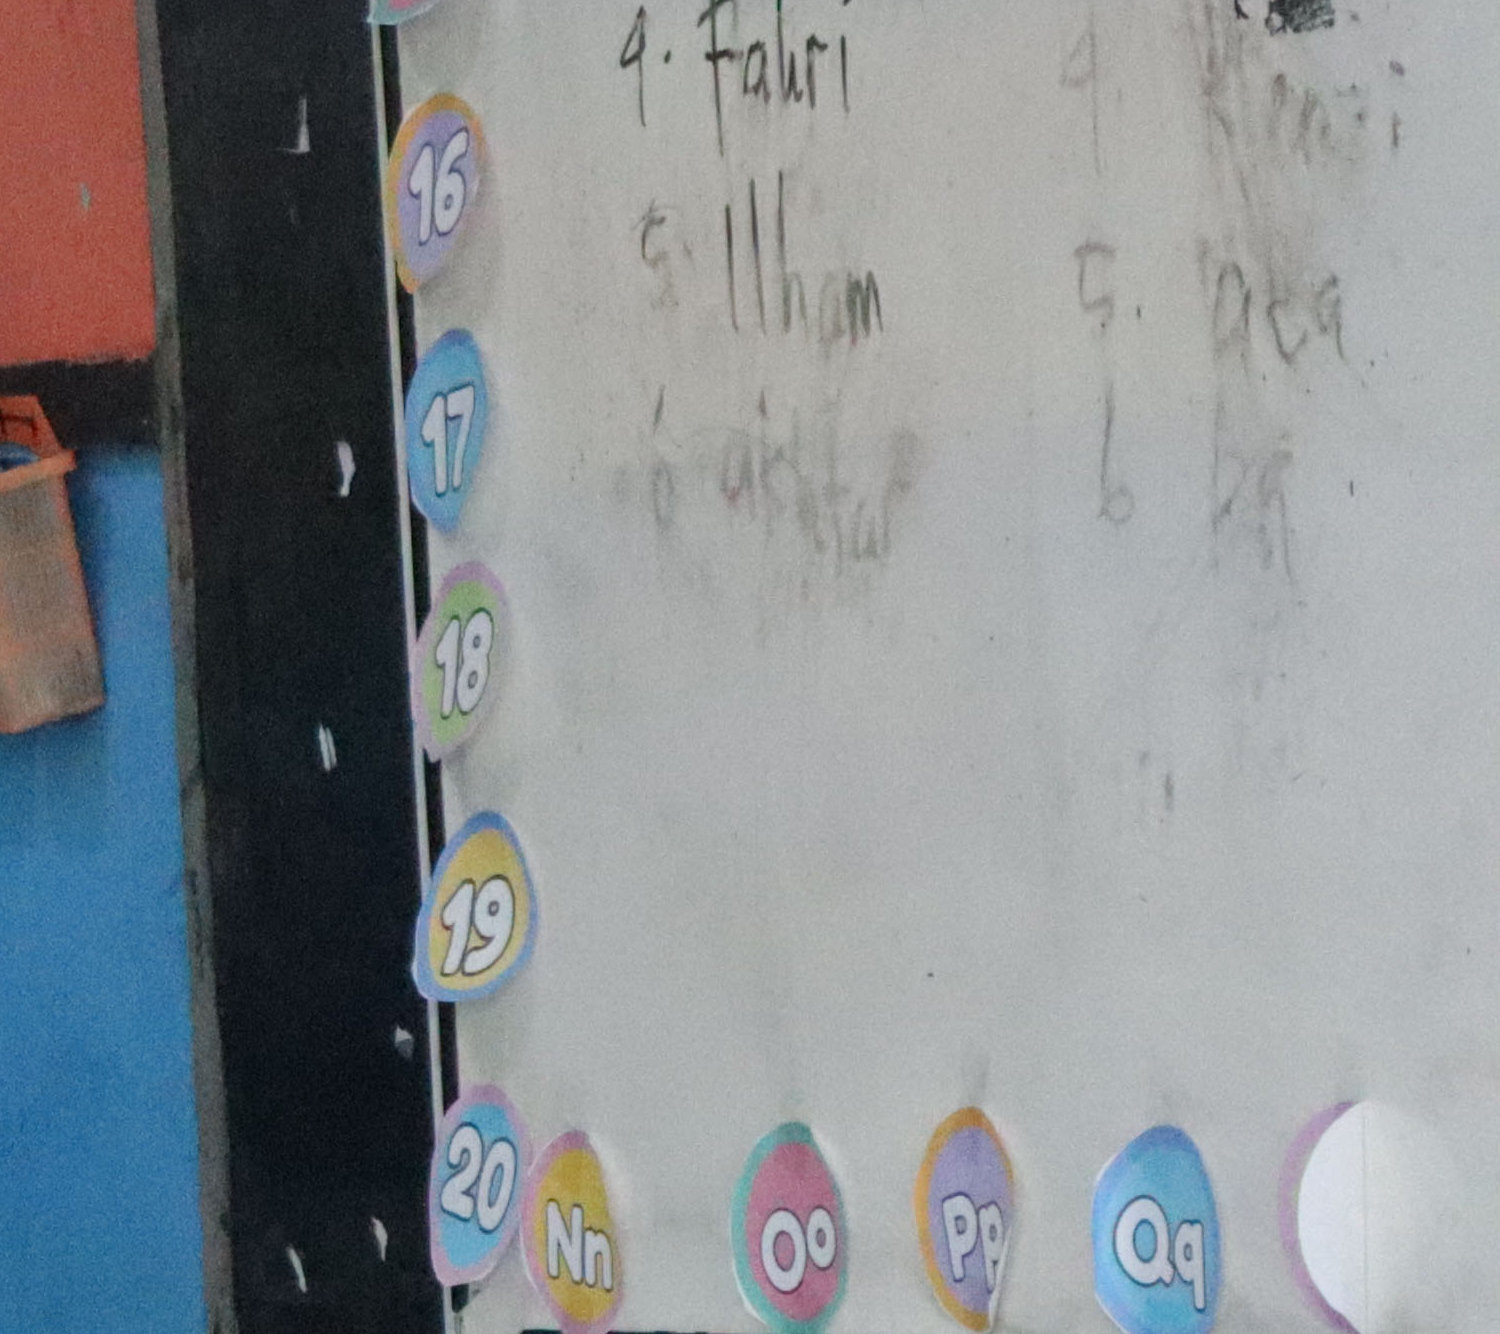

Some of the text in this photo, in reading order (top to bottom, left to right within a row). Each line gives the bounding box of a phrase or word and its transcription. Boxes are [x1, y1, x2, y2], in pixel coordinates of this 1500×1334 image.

[408, 126, 470, 247] 16
[420, 383, 476, 498] 17
[435, 607, 496, 720] 18
[440, 873, 516, 978] 19
[440, 1121, 518, 1235] 20
[545, 1197, 614, 1292] Nn
[760, 1205, 837, 1295] Oo
[941, 1192, 1005, 1292] Pp
[1113, 1194, 1207, 1312] Qq
